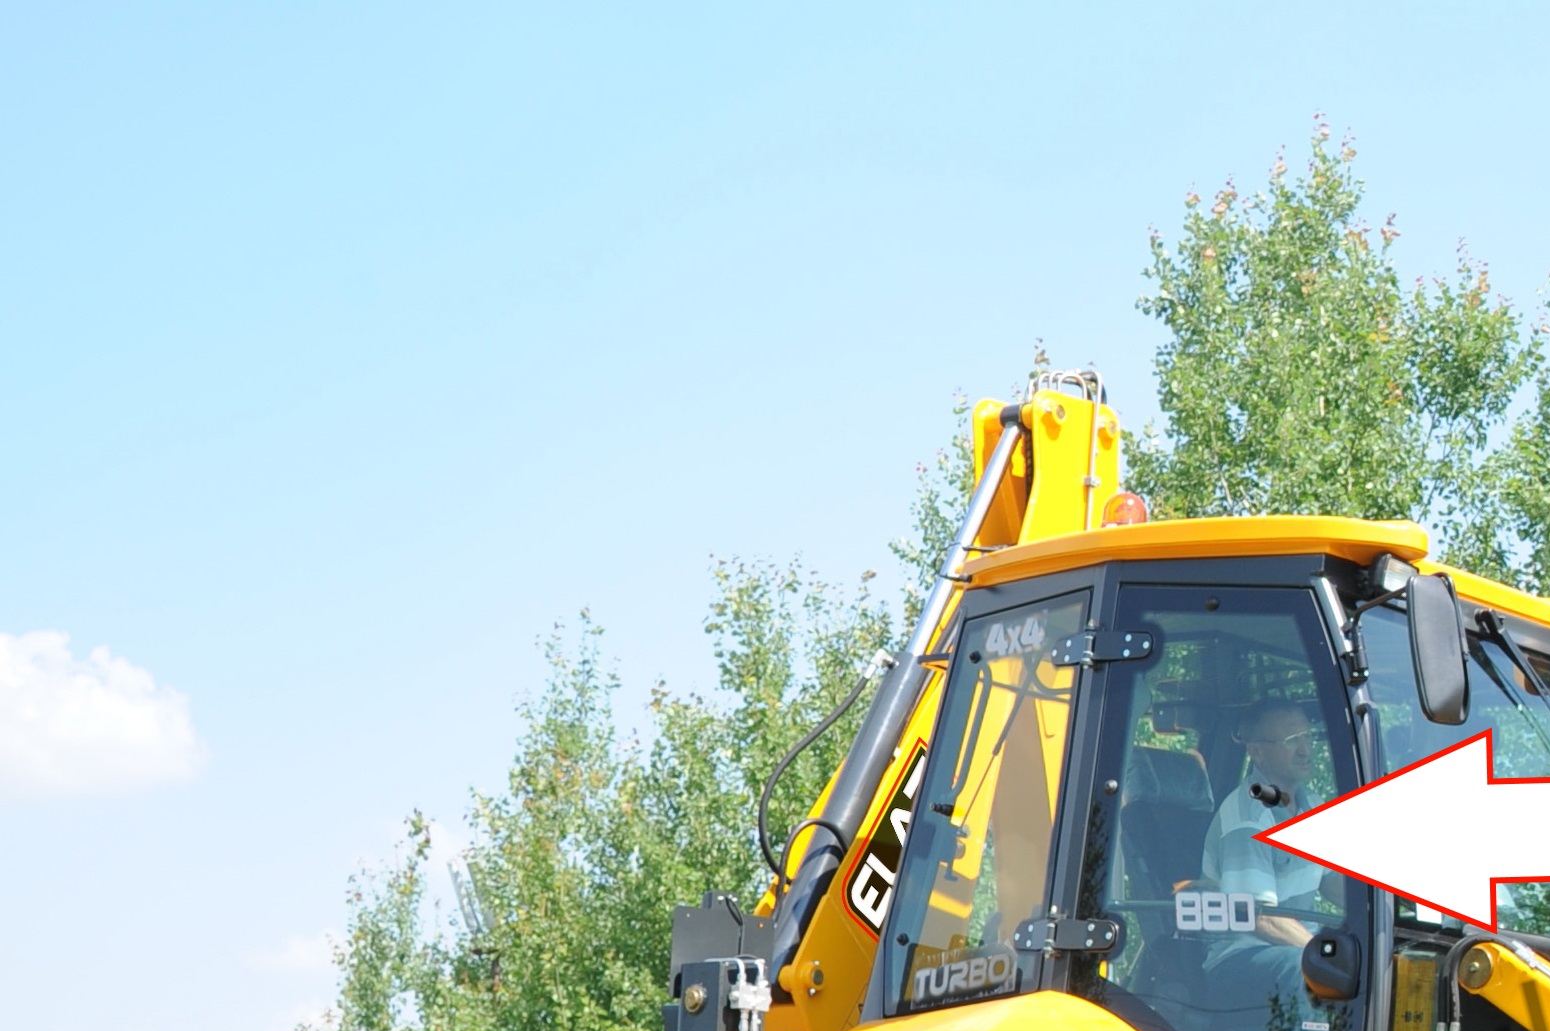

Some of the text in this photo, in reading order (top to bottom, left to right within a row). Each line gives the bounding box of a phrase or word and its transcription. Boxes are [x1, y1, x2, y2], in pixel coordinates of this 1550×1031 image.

[985, 616, 1046, 656] 4x4
[850, 754, 927, 929] ELA
[1175, 891, 1256, 932] 880
[913, 953, 1011, 1004] TURBO
